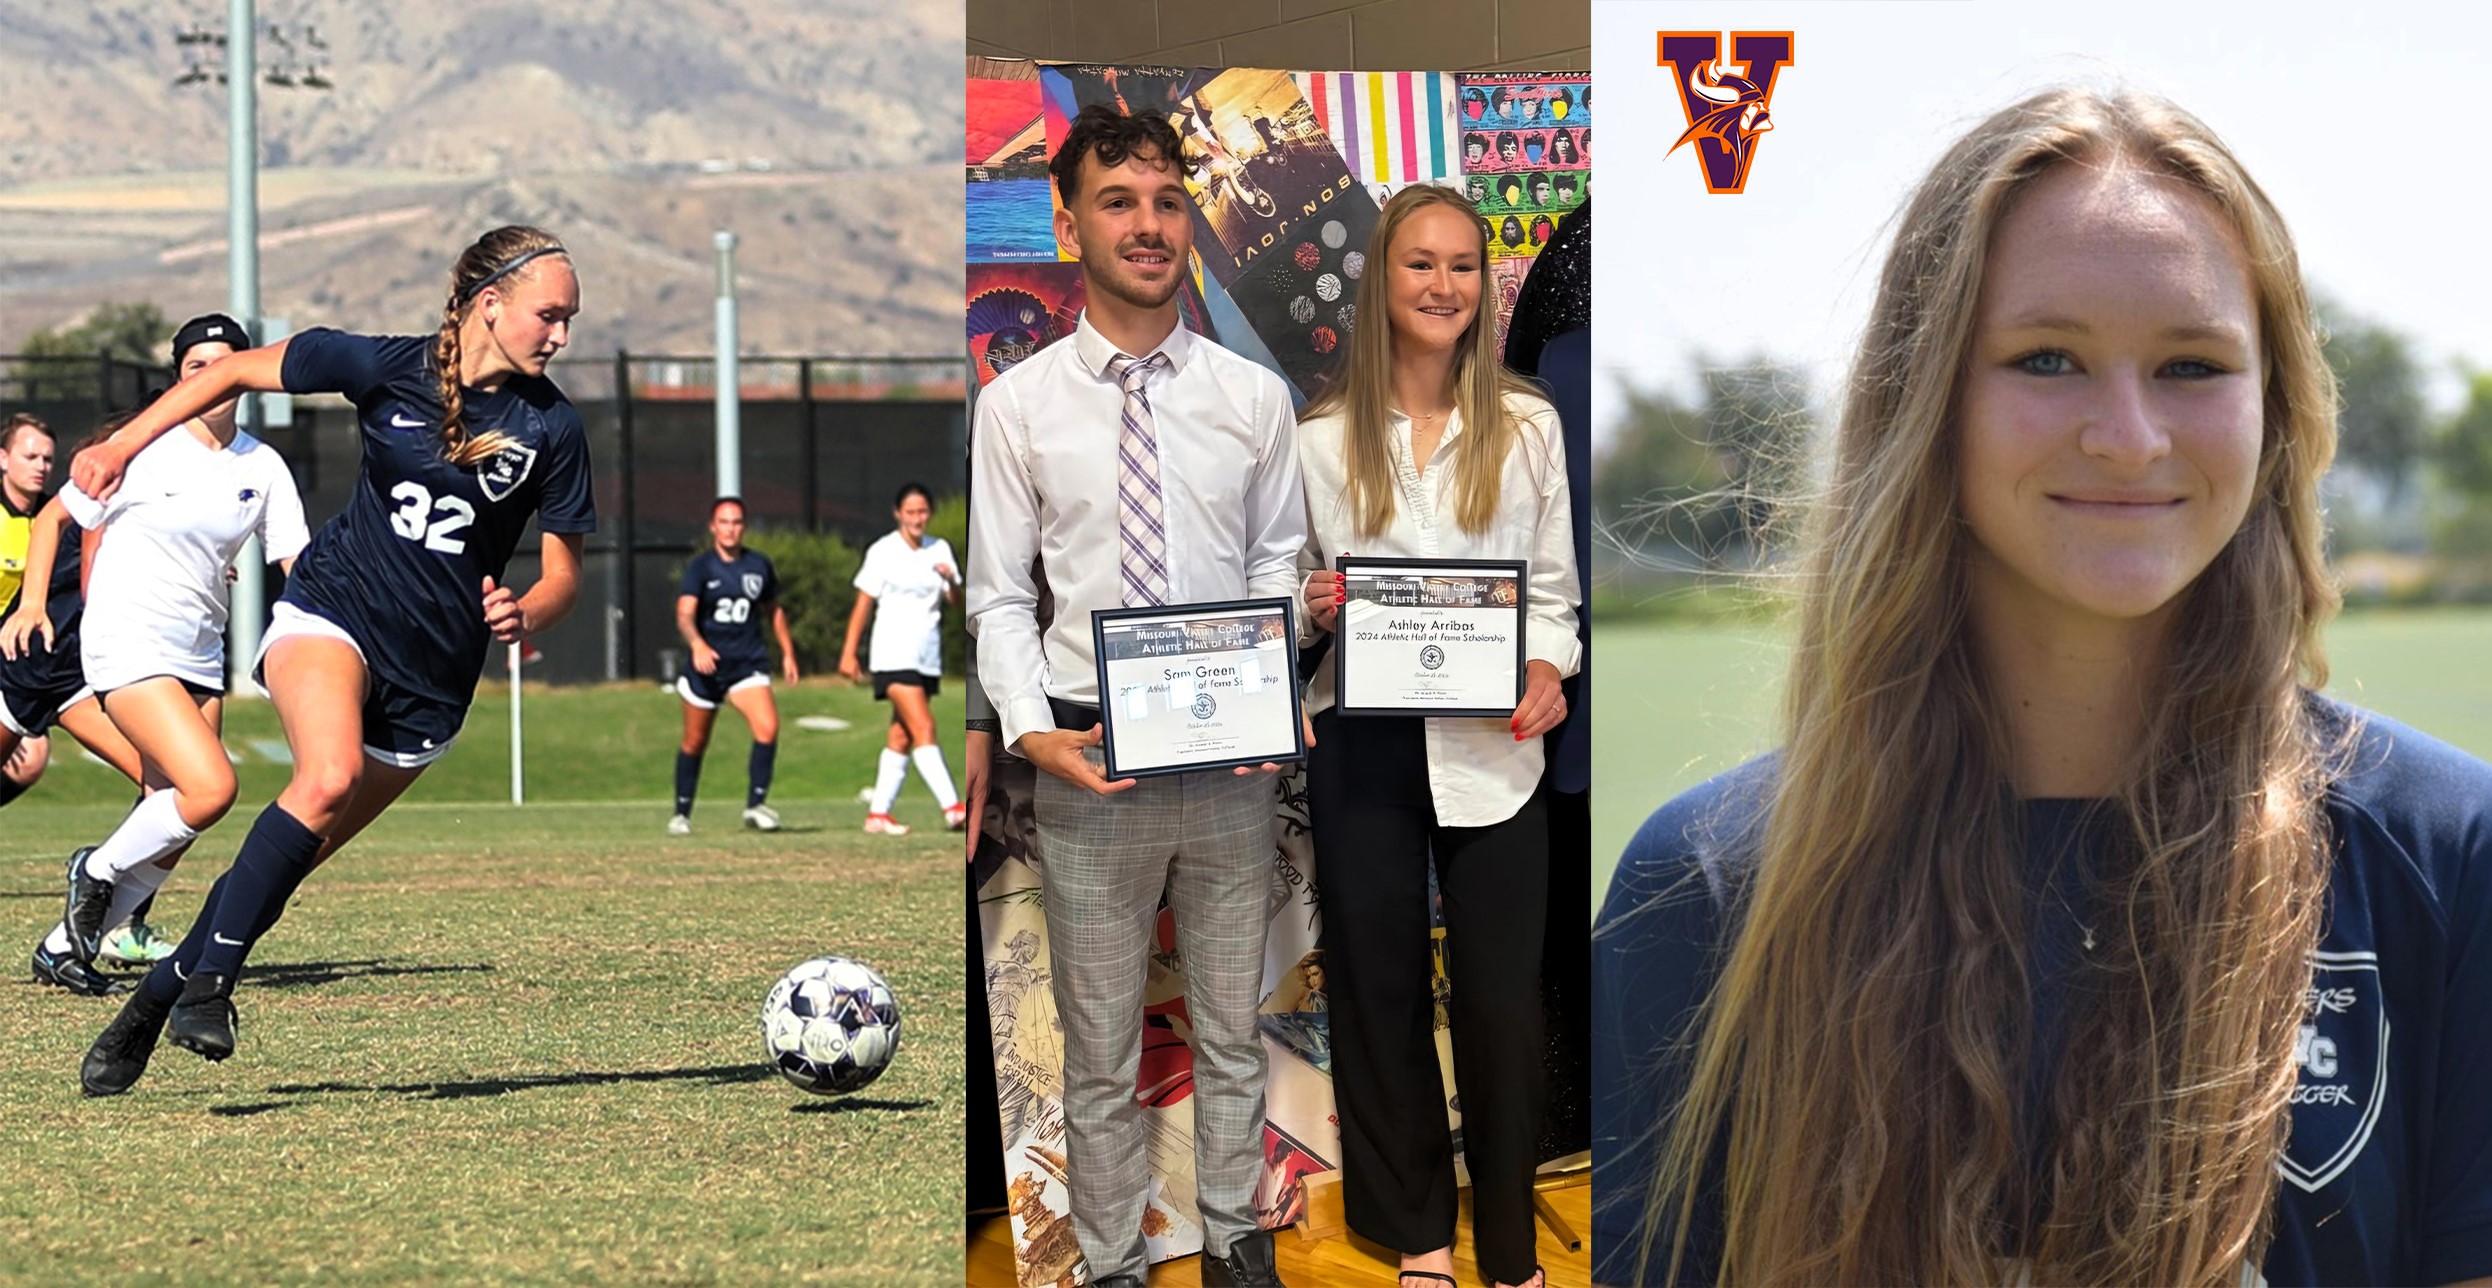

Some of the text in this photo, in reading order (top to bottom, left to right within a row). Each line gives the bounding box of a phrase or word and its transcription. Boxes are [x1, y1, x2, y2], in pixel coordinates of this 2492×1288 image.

[1234, 174, 1351, 268] BON JOVI
[390, 480, 476, 555] 32
[714, 598, 750, 623] 20
[1355, 632, 1378, 641] 2024
[1463, 633, 1506, 643] Scholarship
[1388, 619, 1475, 633] Ashley Arribas
[1195, 666, 1236, 679] Green
[1018, 1059, 1055, 1087] JUSTICE
